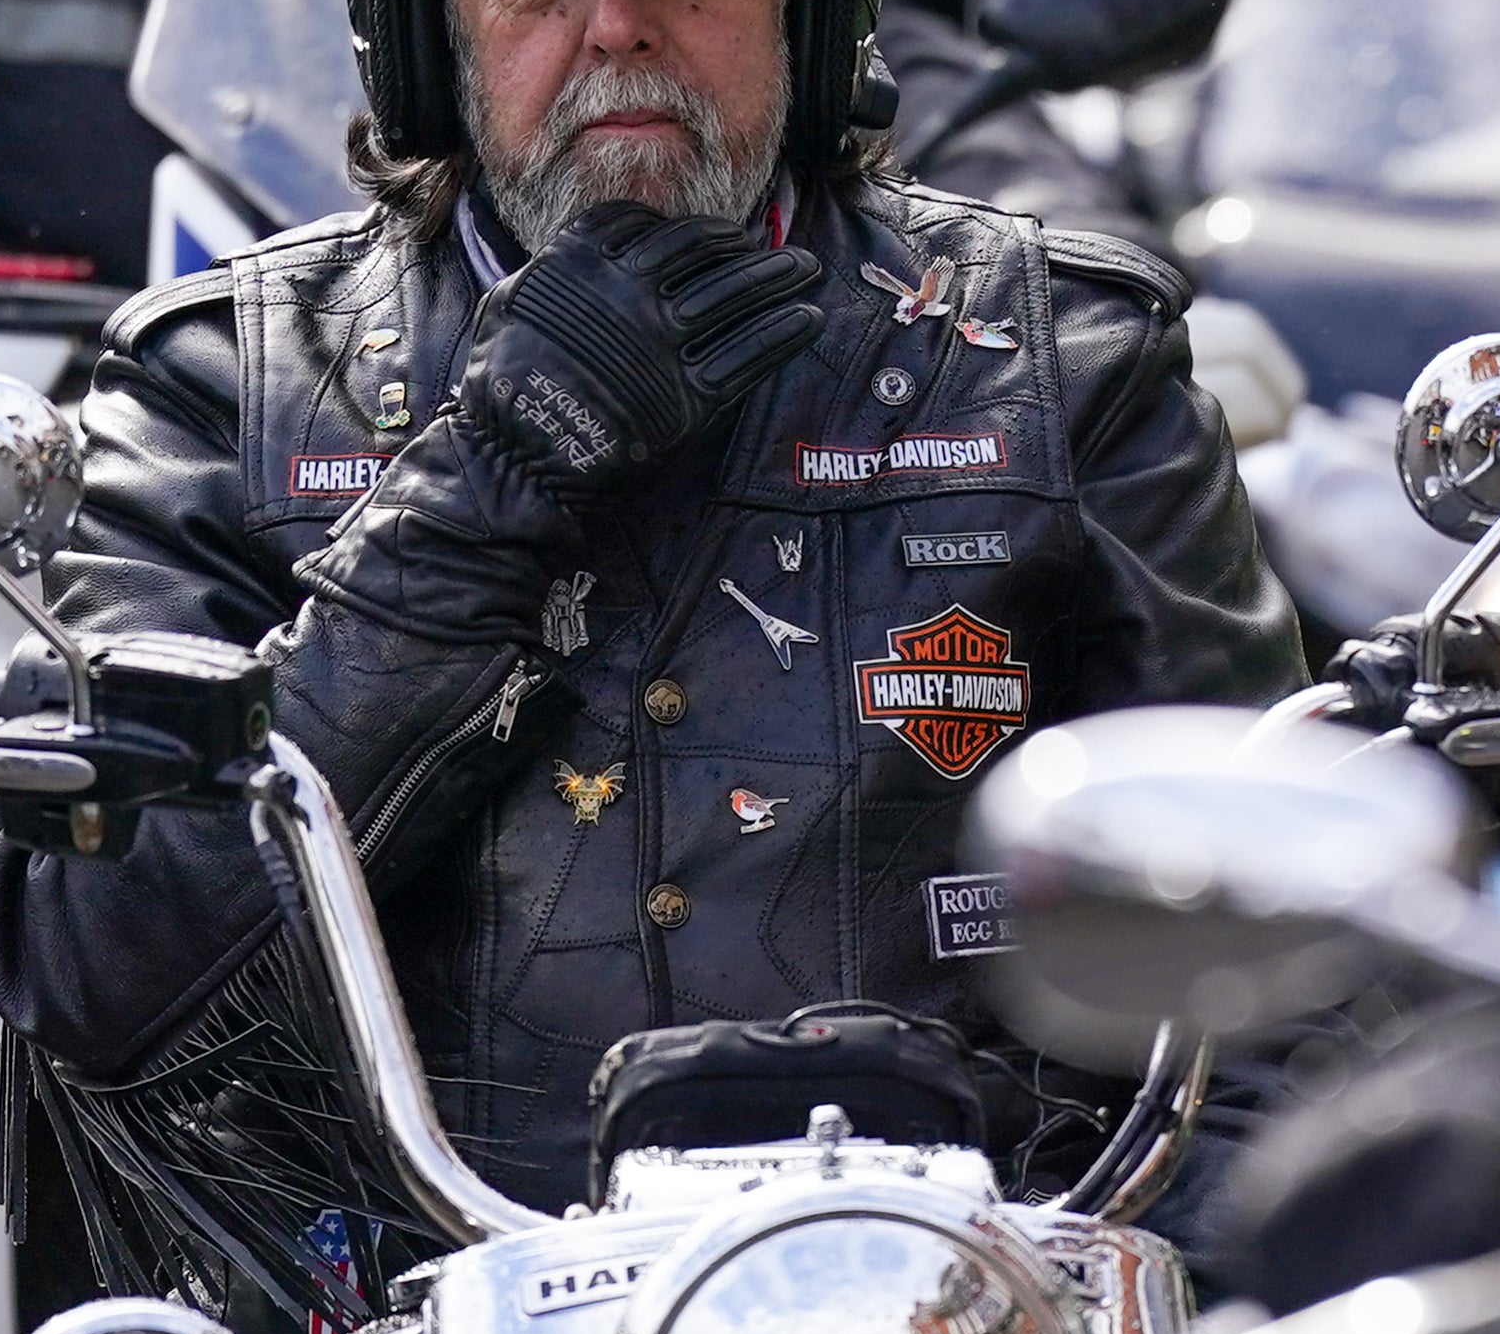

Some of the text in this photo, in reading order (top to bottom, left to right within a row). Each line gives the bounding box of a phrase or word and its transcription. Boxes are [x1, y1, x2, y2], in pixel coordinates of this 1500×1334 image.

[527, 368, 617, 458] PARADISE
[914, 624, 998, 663] MOTOR
[873, 674, 1022, 712] HARLEY-DAVIDSON
[918, 719, 988, 762] CYCLES
[939, 886, 1013, 914] ROUG
[951, 921, 993, 944] EGG
